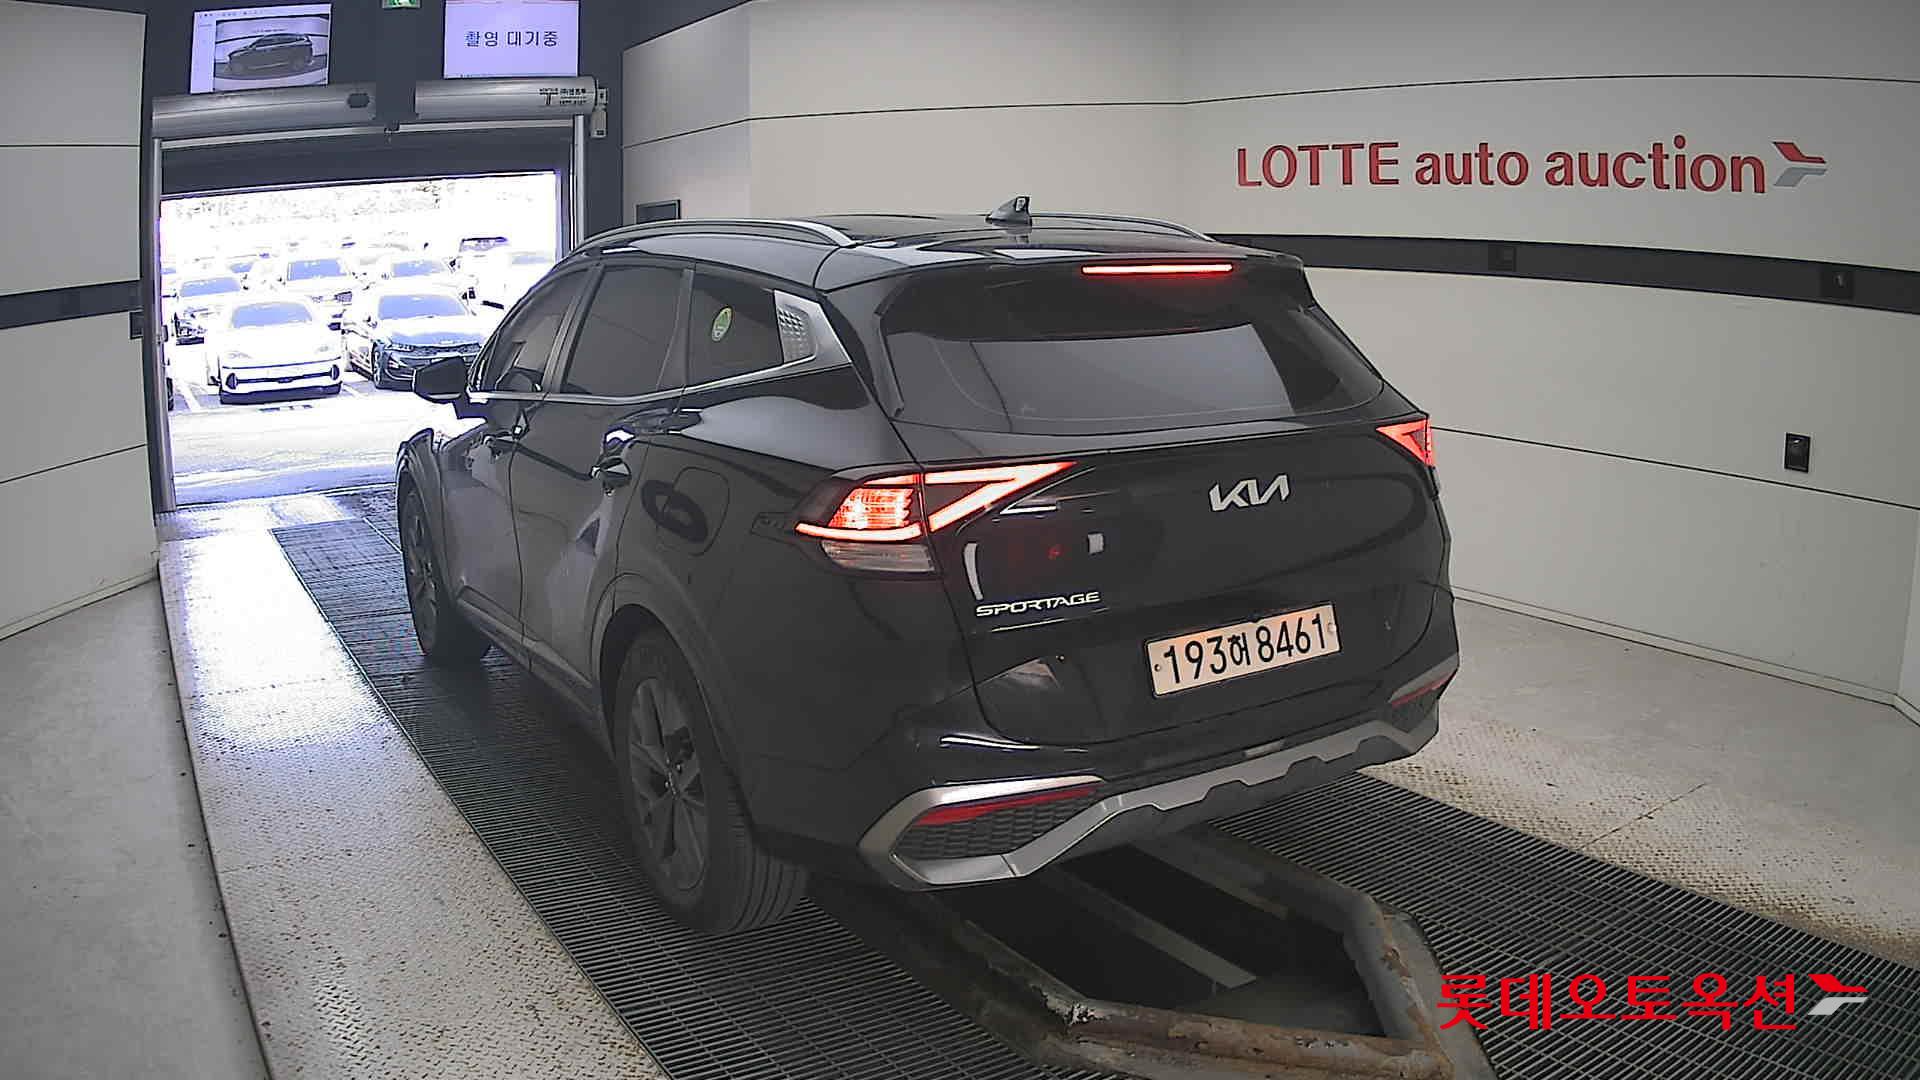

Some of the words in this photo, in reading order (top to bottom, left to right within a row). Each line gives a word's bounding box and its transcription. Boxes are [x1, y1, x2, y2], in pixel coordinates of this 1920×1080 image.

[507, 31, 558, 47] 대기중
[1237, 141, 1400, 188] LOTTE
[1415, 142, 1530, 187] auto
[1544, 134, 1766, 194] auction
[1208, 474, 1290, 511] KIA
[976, 591, 1100, 616] SPORTAGE
